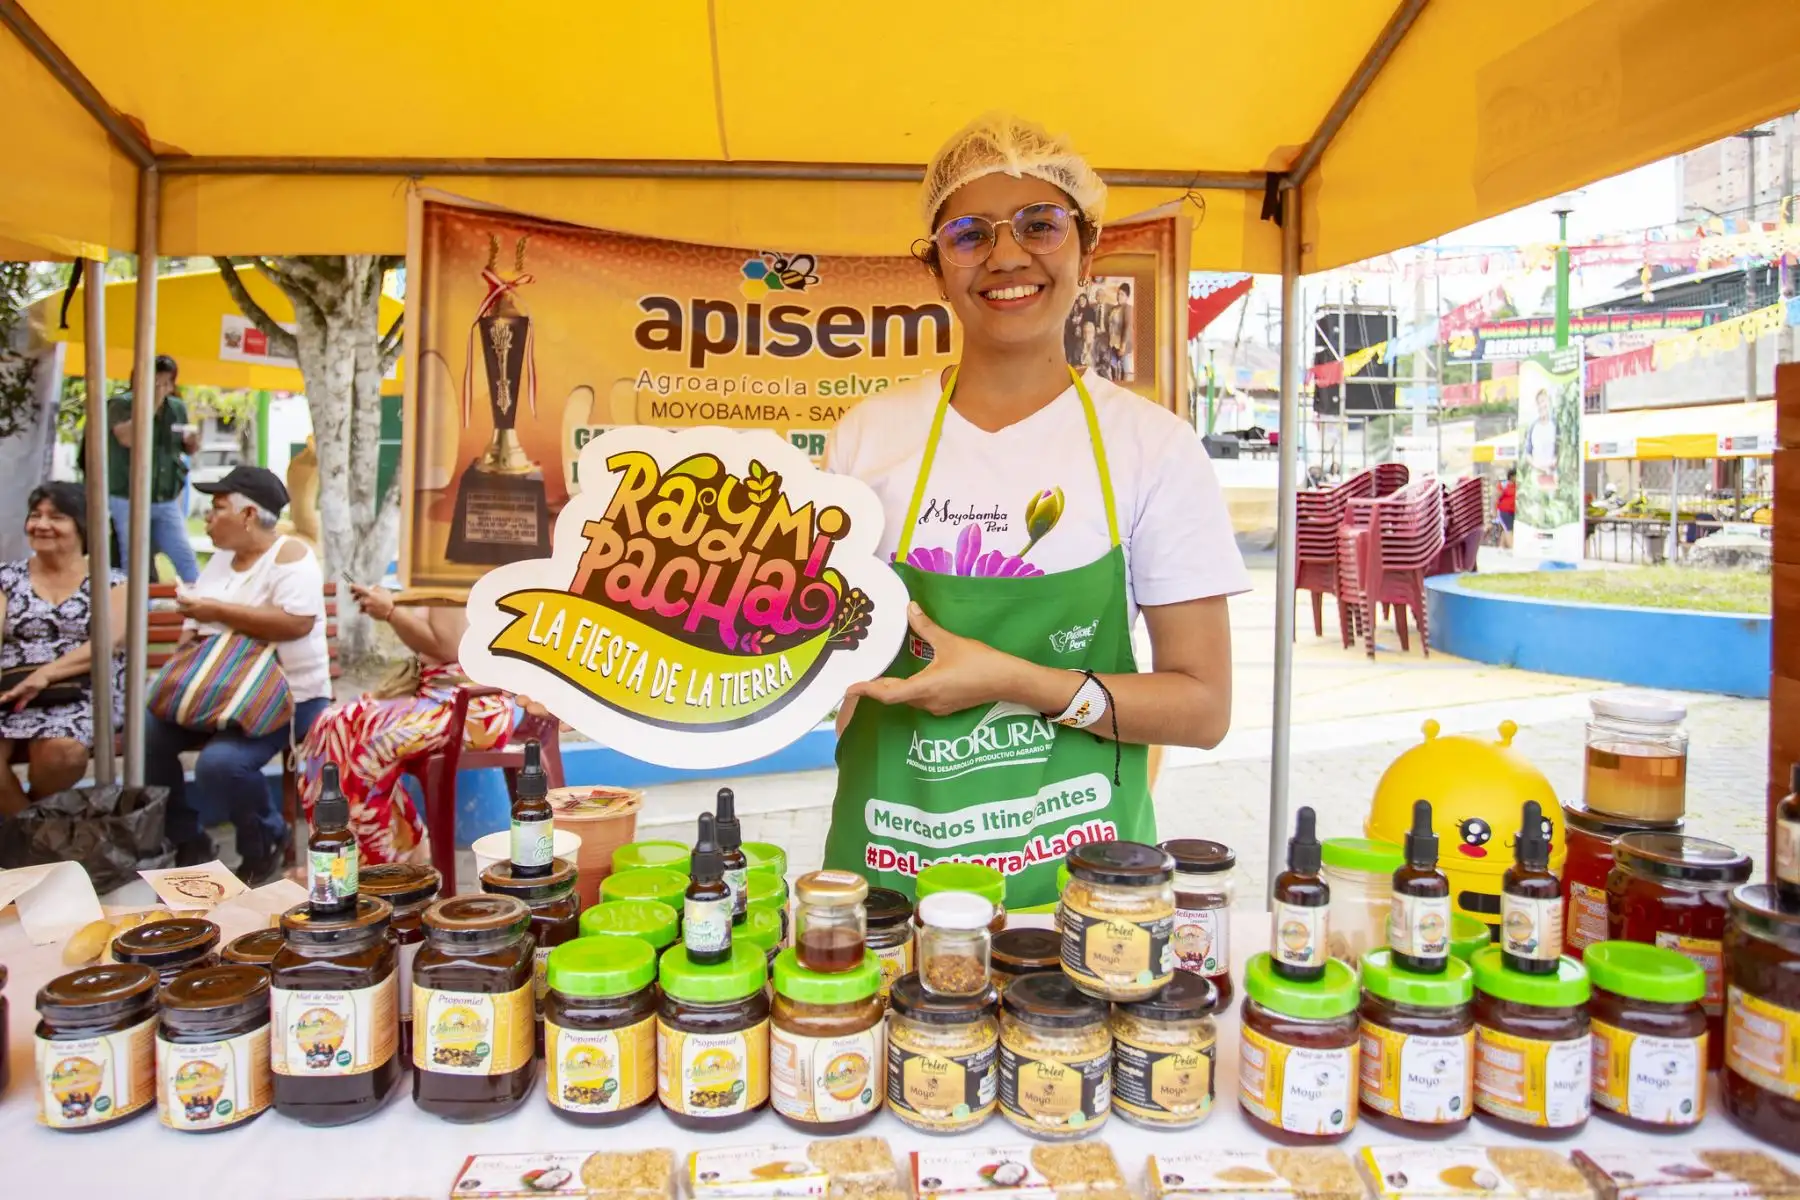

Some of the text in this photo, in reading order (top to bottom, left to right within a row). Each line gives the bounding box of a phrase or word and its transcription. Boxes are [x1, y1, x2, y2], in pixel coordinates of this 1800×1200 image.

[634, 296, 952, 369] apisem
[636, 370, 807, 396] Agroapícola
[818, 374, 888, 396] selva
[650, 401, 790, 421] MOYOBAMBA
[918, 498, 1008, 526] Moyobamba
[984, 521, 1008, 532] Perú
[527, 600, 793, 708] LA FIESTA DE LA TIERRA
[937, 758, 974, 773] DESARROLLO
[975, 750, 1015, 765] PRODUCTIVO
[1016, 745, 1045, 757] AGRARIO
[874, 787, 1097, 840] Mercados Itineantes
[438, 993, 484, 1006] Propomiel
[564, 1032, 608, 1044] Propomiel
[691, 1036, 737, 1048] Propomiel
